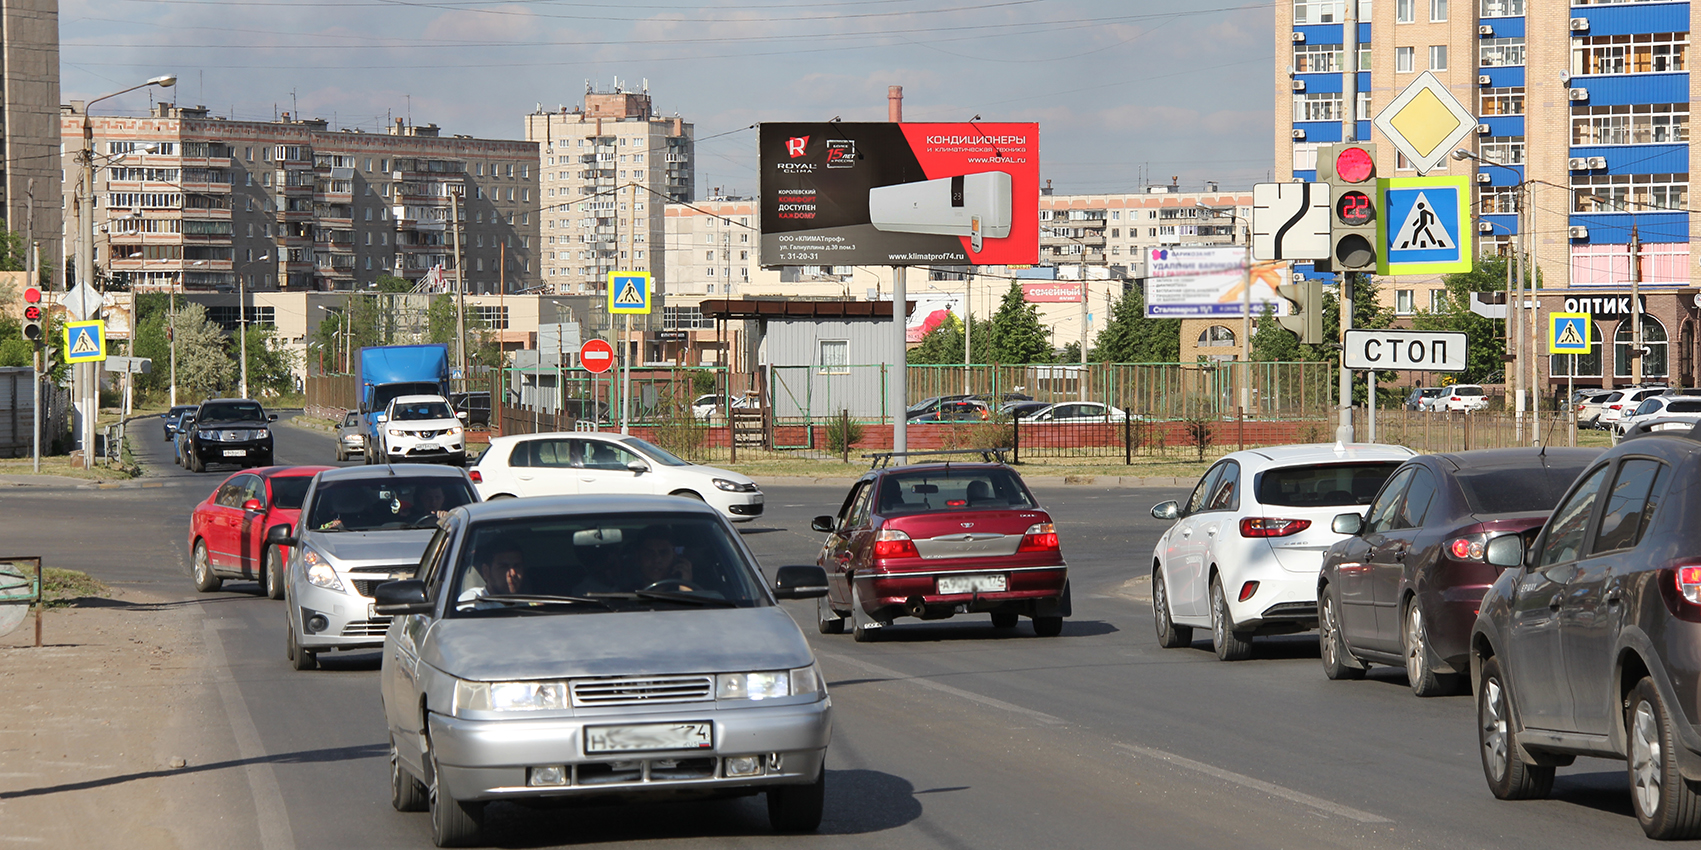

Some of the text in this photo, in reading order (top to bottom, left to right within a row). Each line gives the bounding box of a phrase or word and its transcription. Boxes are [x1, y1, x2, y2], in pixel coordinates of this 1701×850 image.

[926, 135, 1026, 145] КОНДИЦИОНЕРЫ
[826, 148, 845, 164] 15
[967, 156, 1026, 164] www.ROYAL.ru
[778, 204, 816, 212] ДОСТУПЕН
[1343, 195, 1369, 218] 22
[795, 235, 845, 243] «КЛИМАТпроф»
[787, 252, 818, 260] 31-20-31
[888, 252, 964, 261] www.klimatprof74.ru
[1564, 297, 1645, 315] ОПТИКА
[1363, 338, 1447, 364] СТОП
